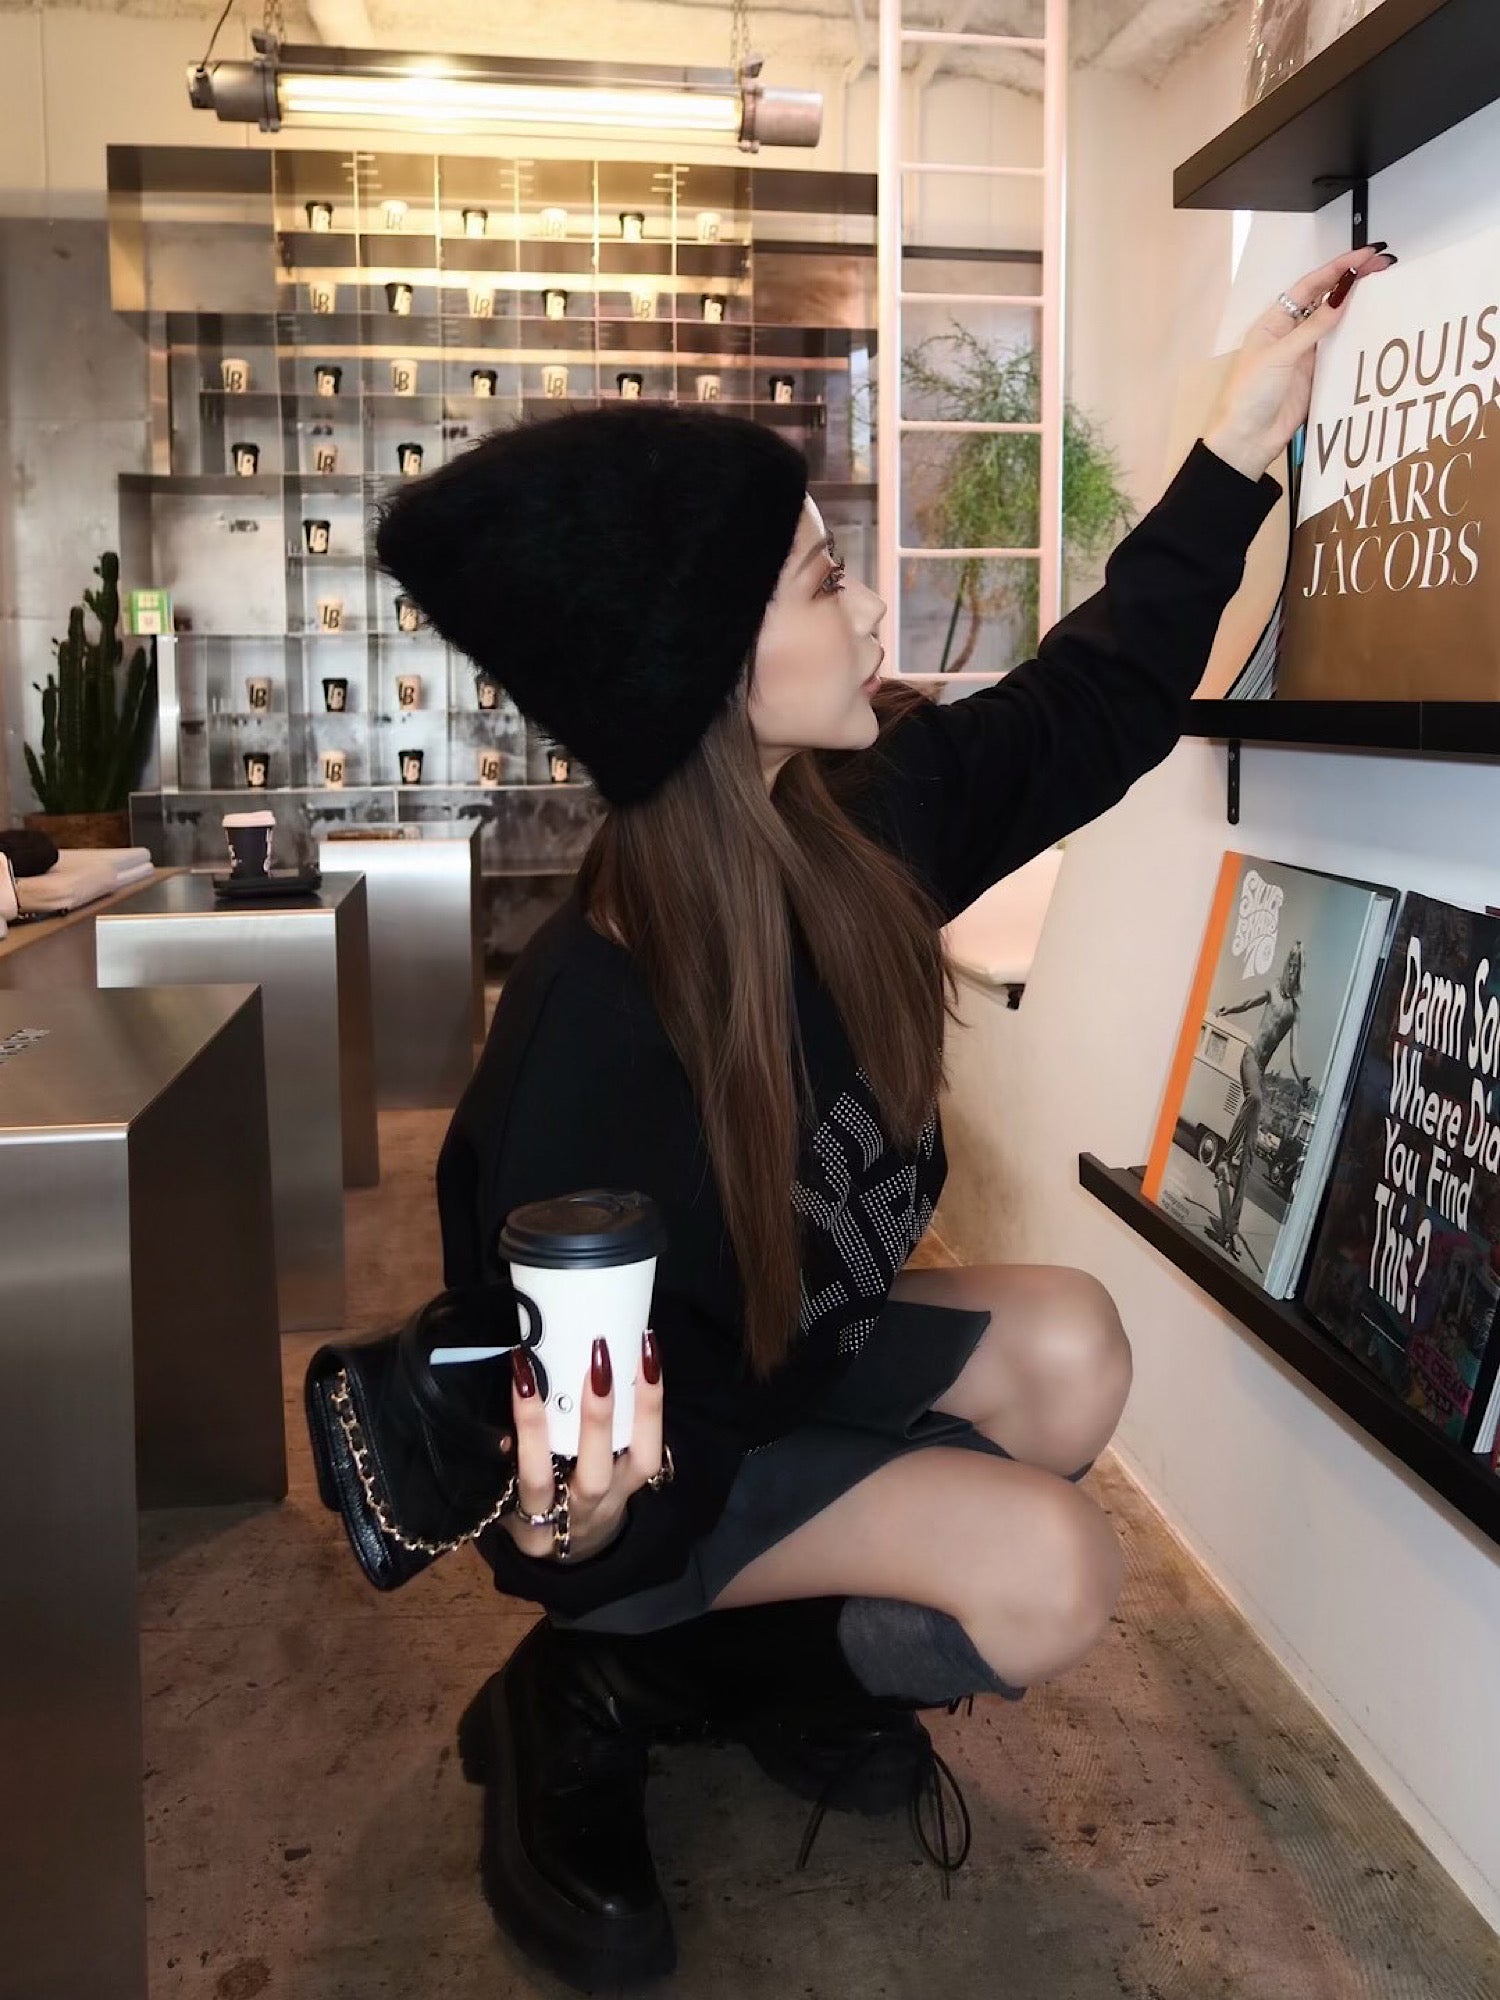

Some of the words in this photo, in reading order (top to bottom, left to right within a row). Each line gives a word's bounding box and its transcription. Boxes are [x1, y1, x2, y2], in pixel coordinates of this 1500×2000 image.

[1354, 305, 1499, 406] LOUIS
[1331, 452, 1472, 533] MARC
[1303, 520, 1481, 598] JACOBS
[322, 605, 340, 629] LB
[249, 684, 267, 708] LB
[326, 759, 342, 782] LB
[1398, 936, 1466, 1061] Damn
[1389, 1041, 1461, 1149] Where
[1385, 1117, 1421, 1197] You
[1426, 1145, 1475, 1232] Find
[1369, 1183, 1432, 1324] This?
